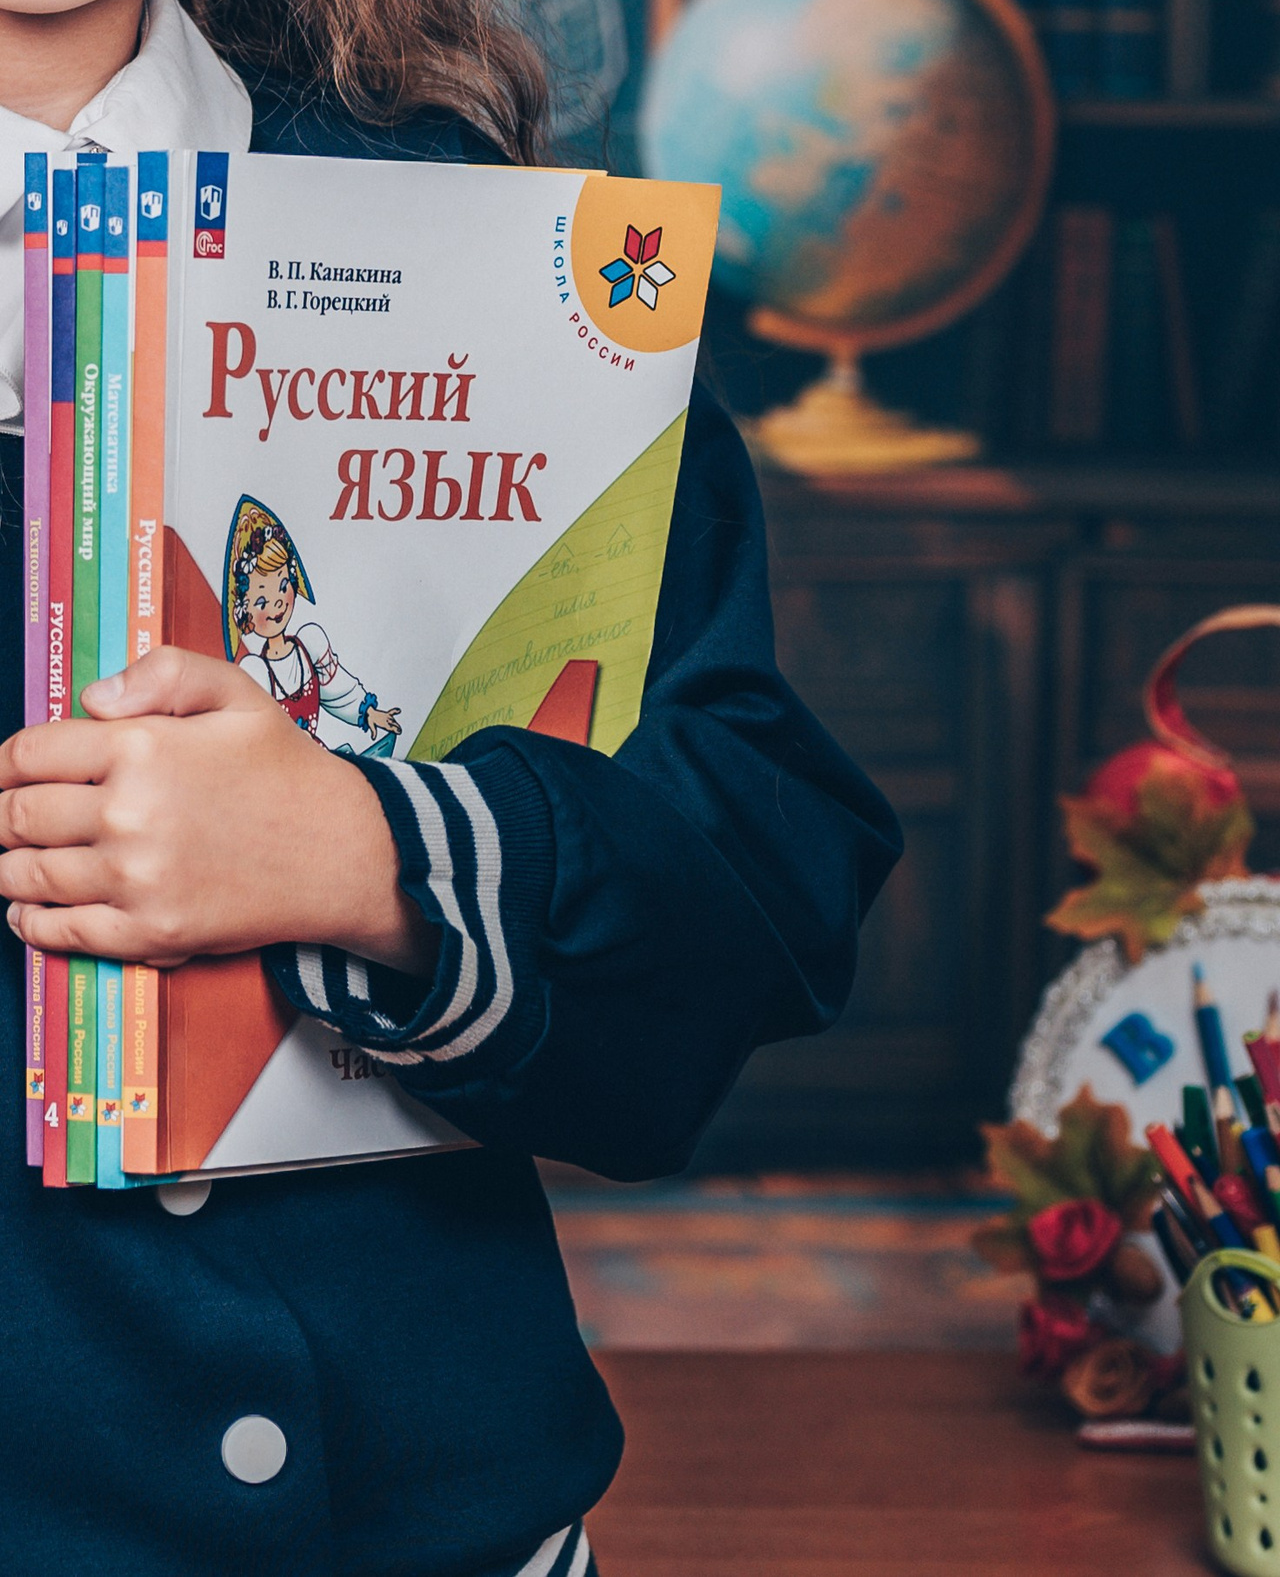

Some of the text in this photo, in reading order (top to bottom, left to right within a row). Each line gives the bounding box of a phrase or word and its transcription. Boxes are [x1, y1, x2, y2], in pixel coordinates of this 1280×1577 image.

[267, 289, 391, 316] В. Г. Горецкий
[268, 260, 402, 284] В. П. Канакина
[553, 216, 635, 371] ШКОЛА РОССИИ
[106, 374, 122, 494] Математика
[202, 321, 477, 442] Русский
[78, 363, 99, 561] Окружающий мир
[30, 518, 42, 624] Технология
[133, 519, 156, 618] Русский
[49, 602, 67, 699] РУССКИЙ
[32, 951, 43, 1062] Школа России
[74, 975, 86, 1085] Школа России
[106, 979, 118, 1089] Школа России
[135, 1020, 147, 1075] России
[44, 1102, 59, 1128] 4
